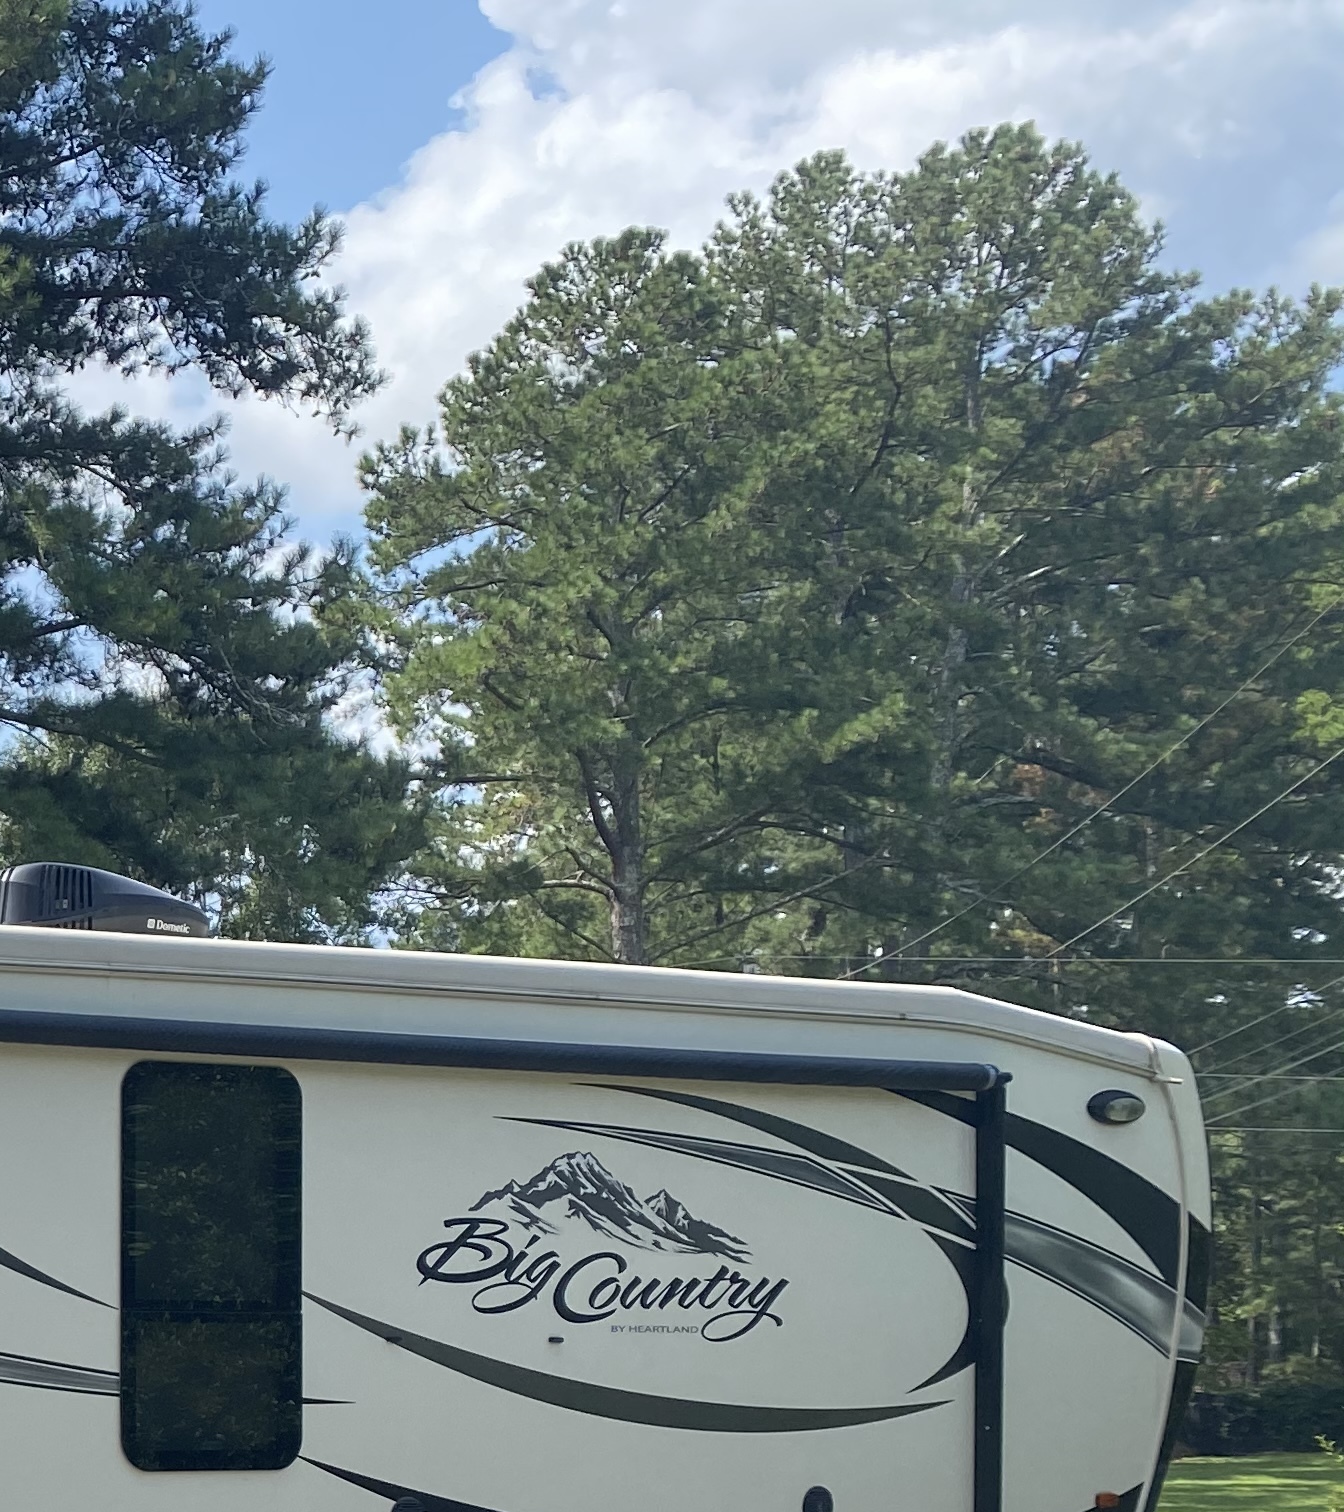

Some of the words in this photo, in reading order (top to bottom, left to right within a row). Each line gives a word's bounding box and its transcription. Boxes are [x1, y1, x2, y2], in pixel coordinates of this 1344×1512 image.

[156, 919, 191, 934] Dometic
[416, 1217, 562, 1314] Big
[553, 1251, 790, 1342] Country
[611, 1325, 626, 1333] BY
[628, 1325, 699, 1334] HEARTLAND
